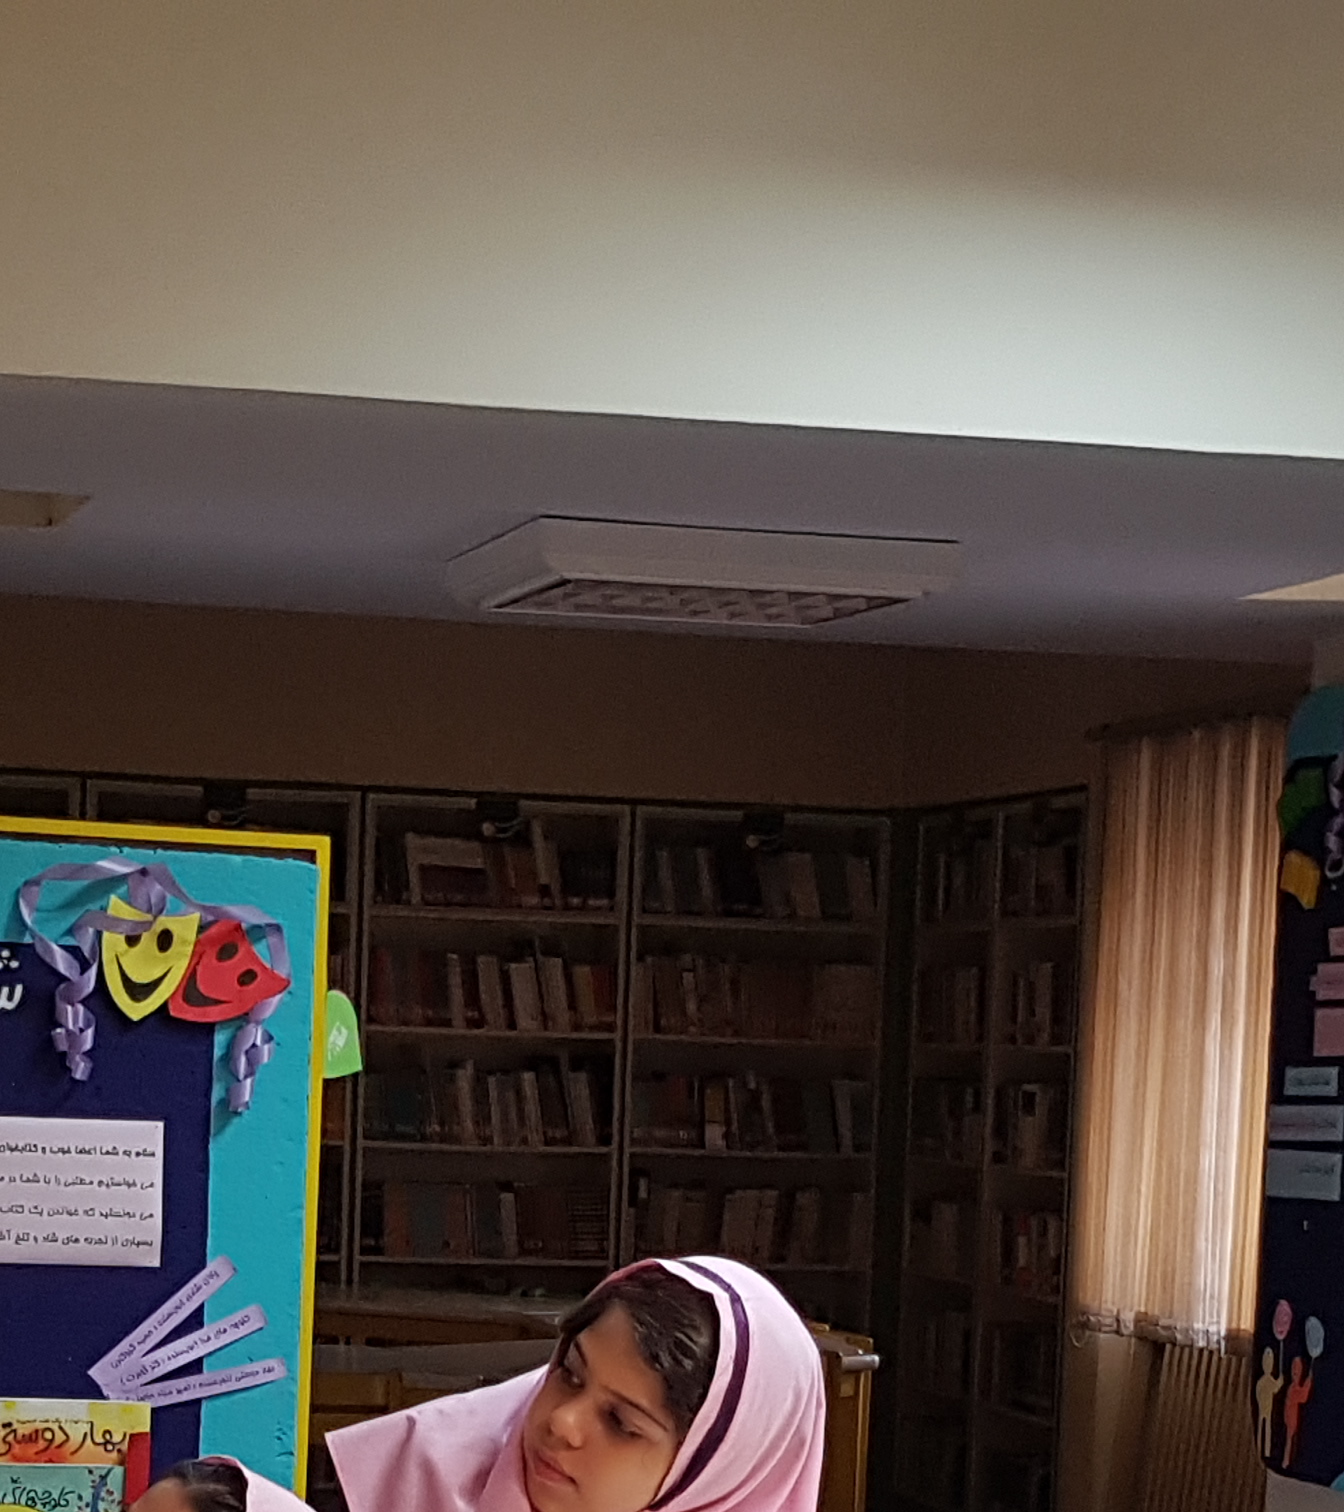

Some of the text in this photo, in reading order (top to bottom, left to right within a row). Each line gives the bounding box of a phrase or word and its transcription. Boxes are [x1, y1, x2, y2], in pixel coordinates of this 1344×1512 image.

[100, 1145, 119, 1156] شما
[20, 1172, 40, 1183] شما
[97, 1176, 137, 1189] خواستیم
[140, 1181, 154, 1190] می
[0, 1203, 25, 1215] کتاب
[28, 1205, 44, 1217] یک
[47, 1207, 79, 1217] خواندن
[83, 1207, 95, 1216] که
[140, 1212, 154, 1221] می
[14, 1232, 30, 1246] تلخ
[61, 1235, 80, 1246] های
[83, 1235, 108, 1246] تجربه
[121, 1236, 153, 1248] بسیاری
[69, 1420, 128, 1456] بهار
